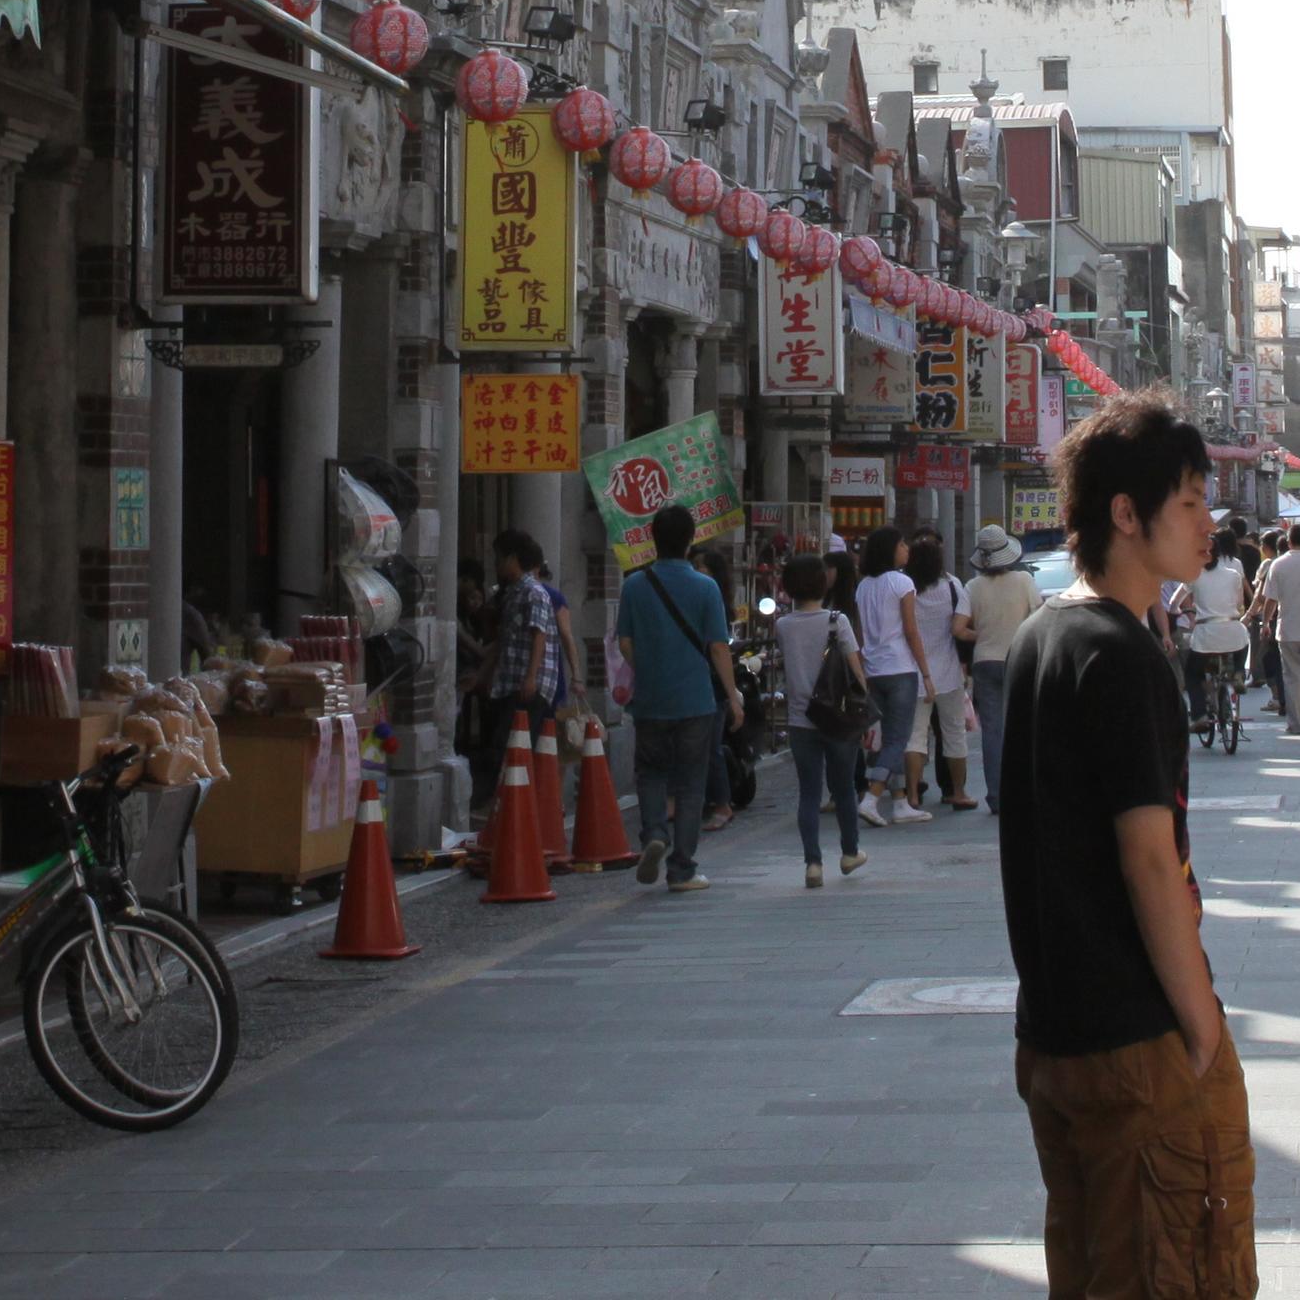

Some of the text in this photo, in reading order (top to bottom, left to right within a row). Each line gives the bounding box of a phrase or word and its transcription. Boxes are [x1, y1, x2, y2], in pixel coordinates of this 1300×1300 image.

[187, 15, 286, 209] 大義成
[176, 210, 293, 243] 木器行
[517, 279, 549, 335] 傢具
[830, 467, 880, 486] 杏仁粉
